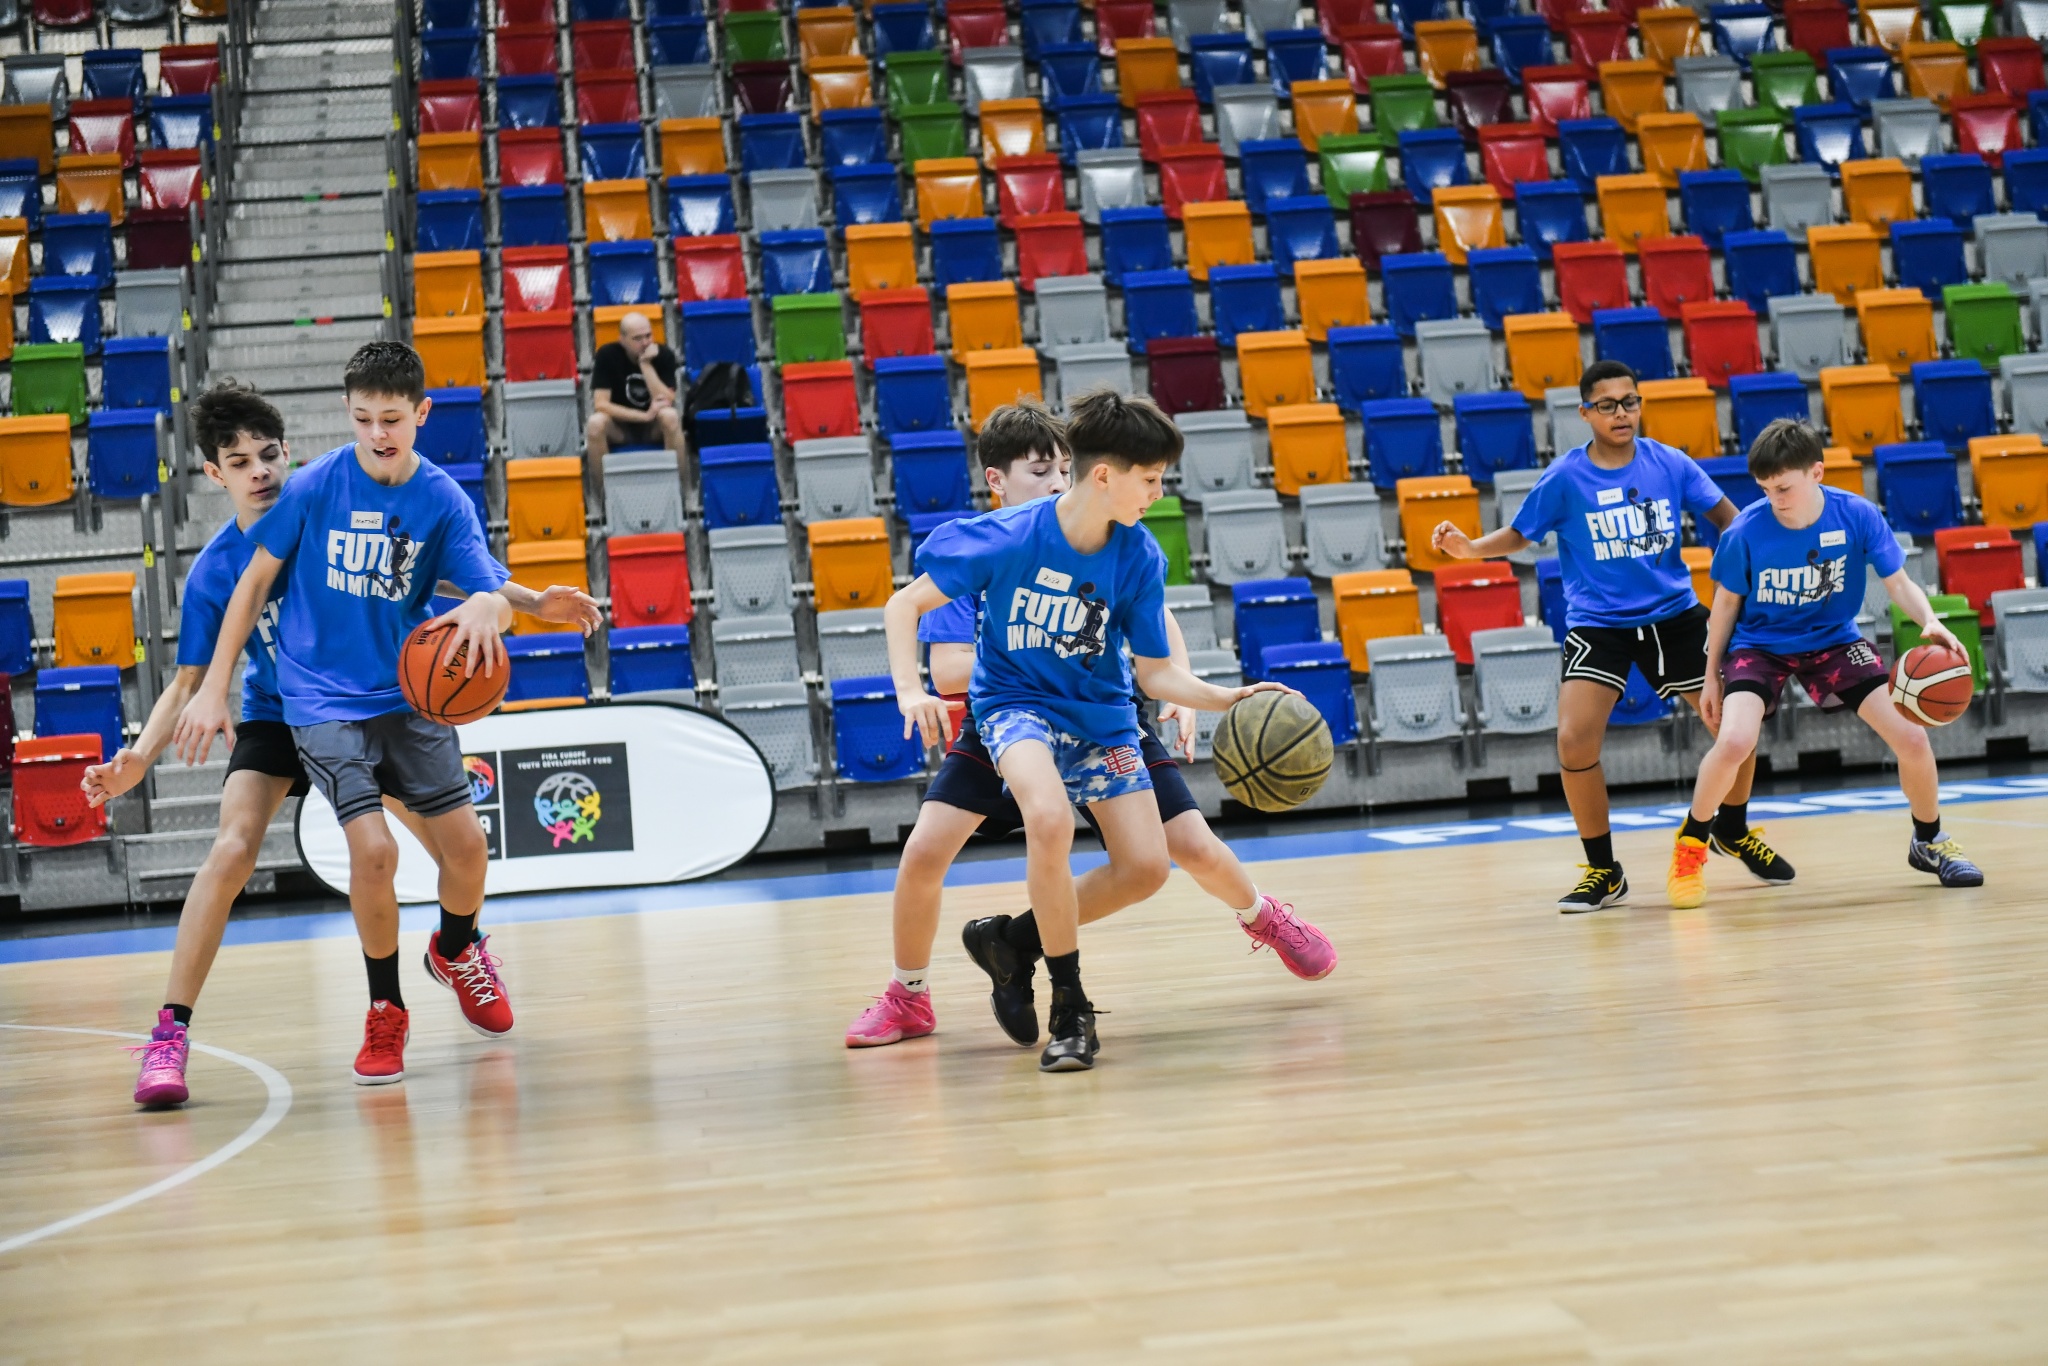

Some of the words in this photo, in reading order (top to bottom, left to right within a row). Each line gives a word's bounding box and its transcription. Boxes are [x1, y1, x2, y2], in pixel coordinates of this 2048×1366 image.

[1593, 541, 1610, 561] IN
[1609, 539, 1630, 559] MY
[327, 566, 346, 592] IN
[347, 573, 369, 598] MY
[1757, 588, 1774, 603] IN
[1775, 589, 1797, 605] MY
[1007, 624, 1026, 652] IN
[1026, 624, 1053, 649] MY
[517, 760, 541, 770] YOUTH
[542, 757, 591, 769] DEVELOPMENT
[593, 756, 613, 765] FUND
[541, 752, 558, 761] FIBA
[560, 750, 587, 760] EUROPE
